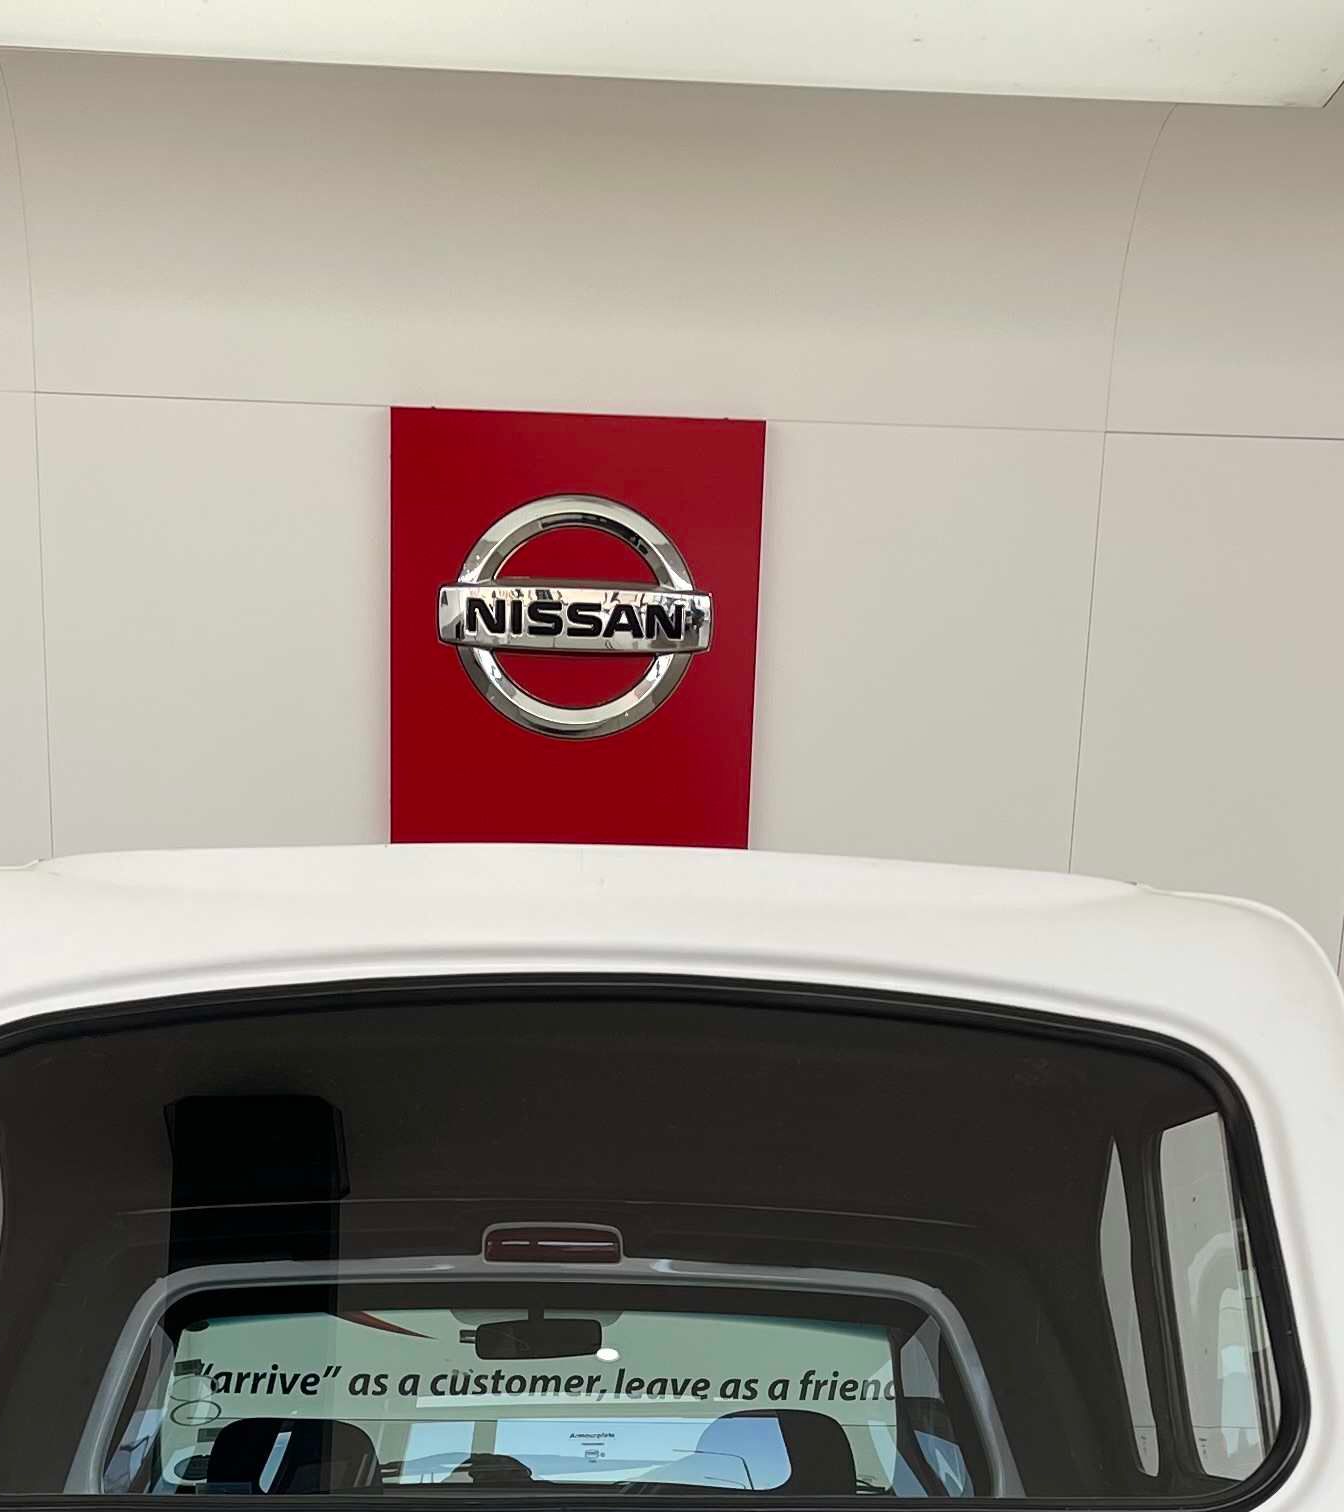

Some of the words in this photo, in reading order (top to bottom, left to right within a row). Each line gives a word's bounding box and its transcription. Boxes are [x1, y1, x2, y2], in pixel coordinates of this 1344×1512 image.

[465, 597, 685, 640] NISSAN
[348, 1372, 389, 1396] as
[398, 1373, 421, 1396] a
[614, 1367, 710, 1400] leave
[719, 1375, 760, 1400] as
[767, 1376, 790, 1401] a
